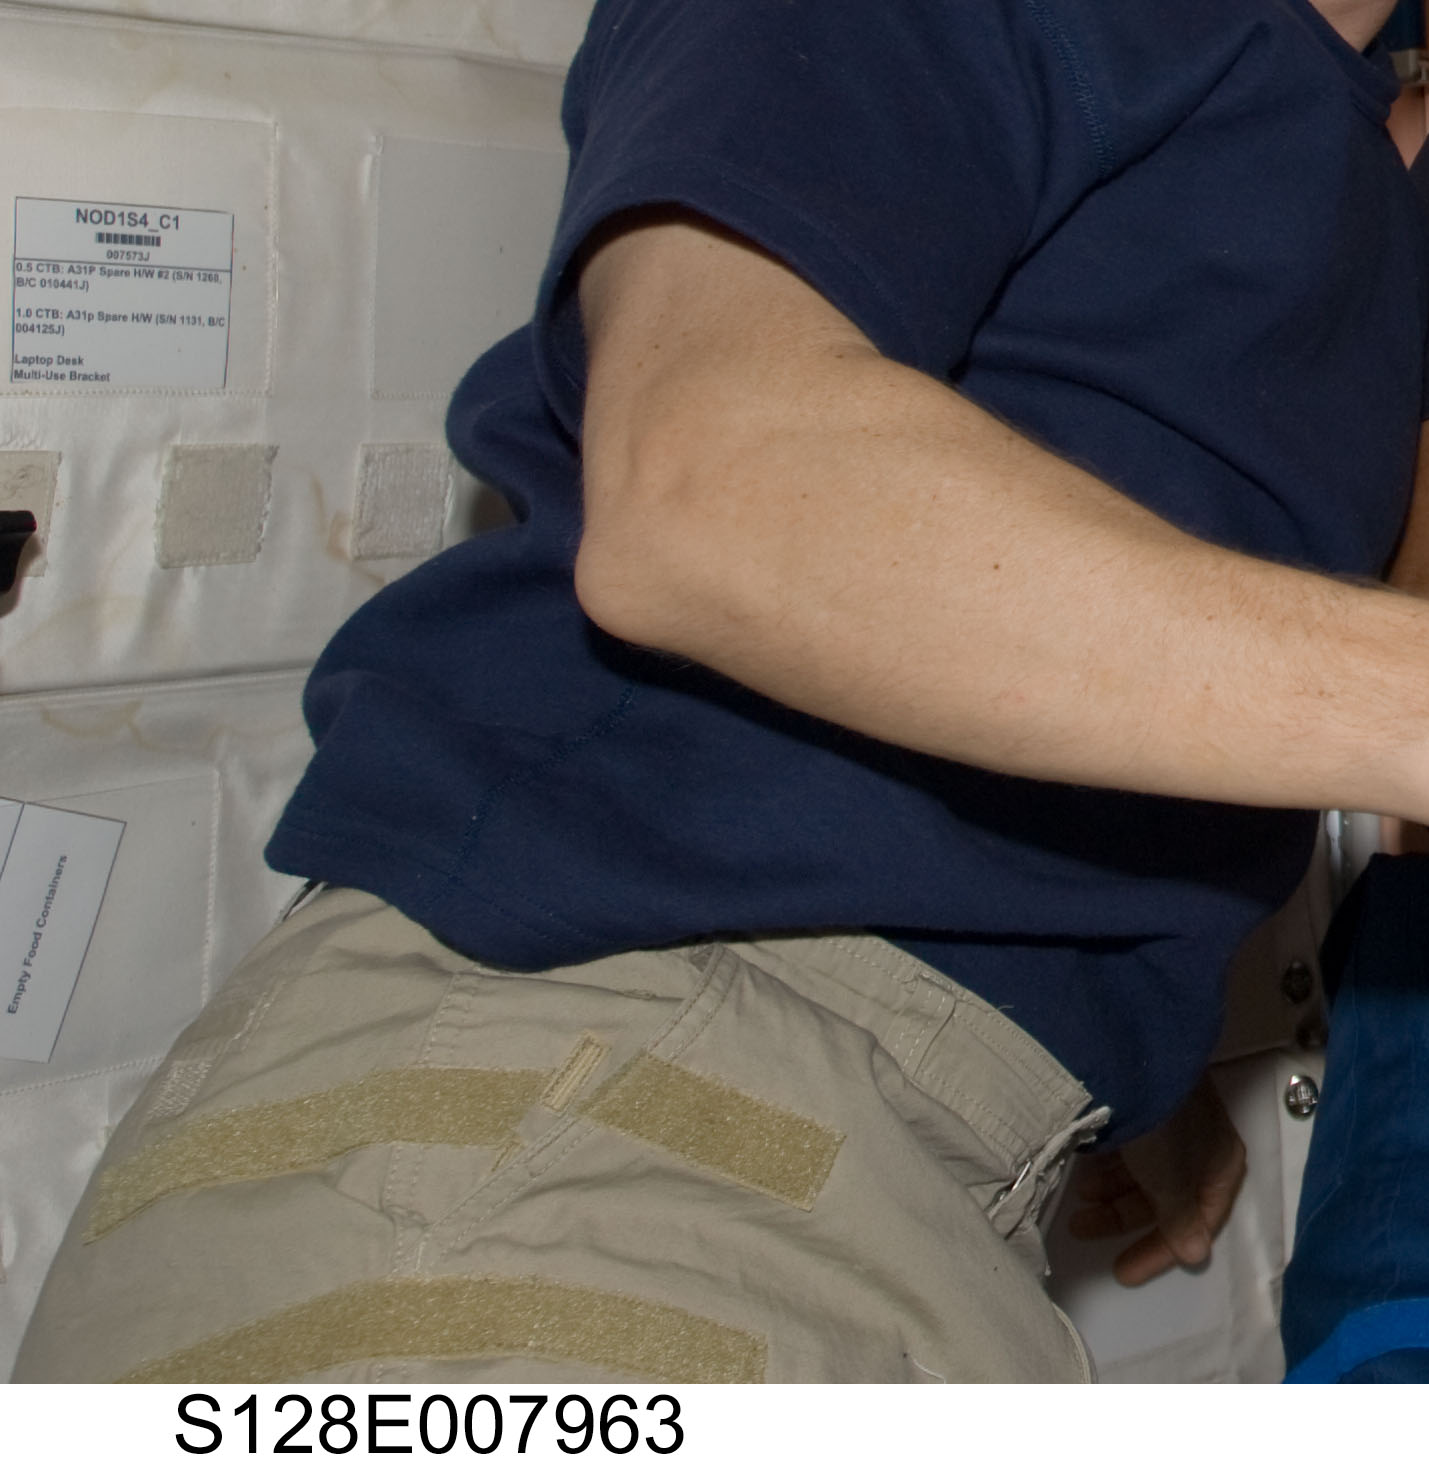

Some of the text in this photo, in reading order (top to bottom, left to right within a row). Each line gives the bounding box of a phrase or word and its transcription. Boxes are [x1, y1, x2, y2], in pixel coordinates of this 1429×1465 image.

[74, 207, 181, 233] NOD1S4_C1
[16, 263, 33, 274] 0.5
[36, 263, 65, 275] CTB:
[67, 264, 96, 276] A31P
[99, 266, 131, 280] Spare
[133, 268, 155, 280] H/W
[172, 270, 194, 283] (S/N
[16, 277, 37, 288] B/C
[16, 307, 33, 319] 1.0
[35, 308, 63, 320] CTB:
[66, 310, 95, 324] A31p
[97, 312, 129, 325] Spare
[131, 312, 153, 324] H/W
[155, 314, 177, 327] (S/N
[208, 316, 226, 328] B/C
[14, 353, 85, 368] Laptop Desk
[13, 369, 111, 383] Multi-Use Bracket
[7, 854, 68, 1016] Empty Food Containers
